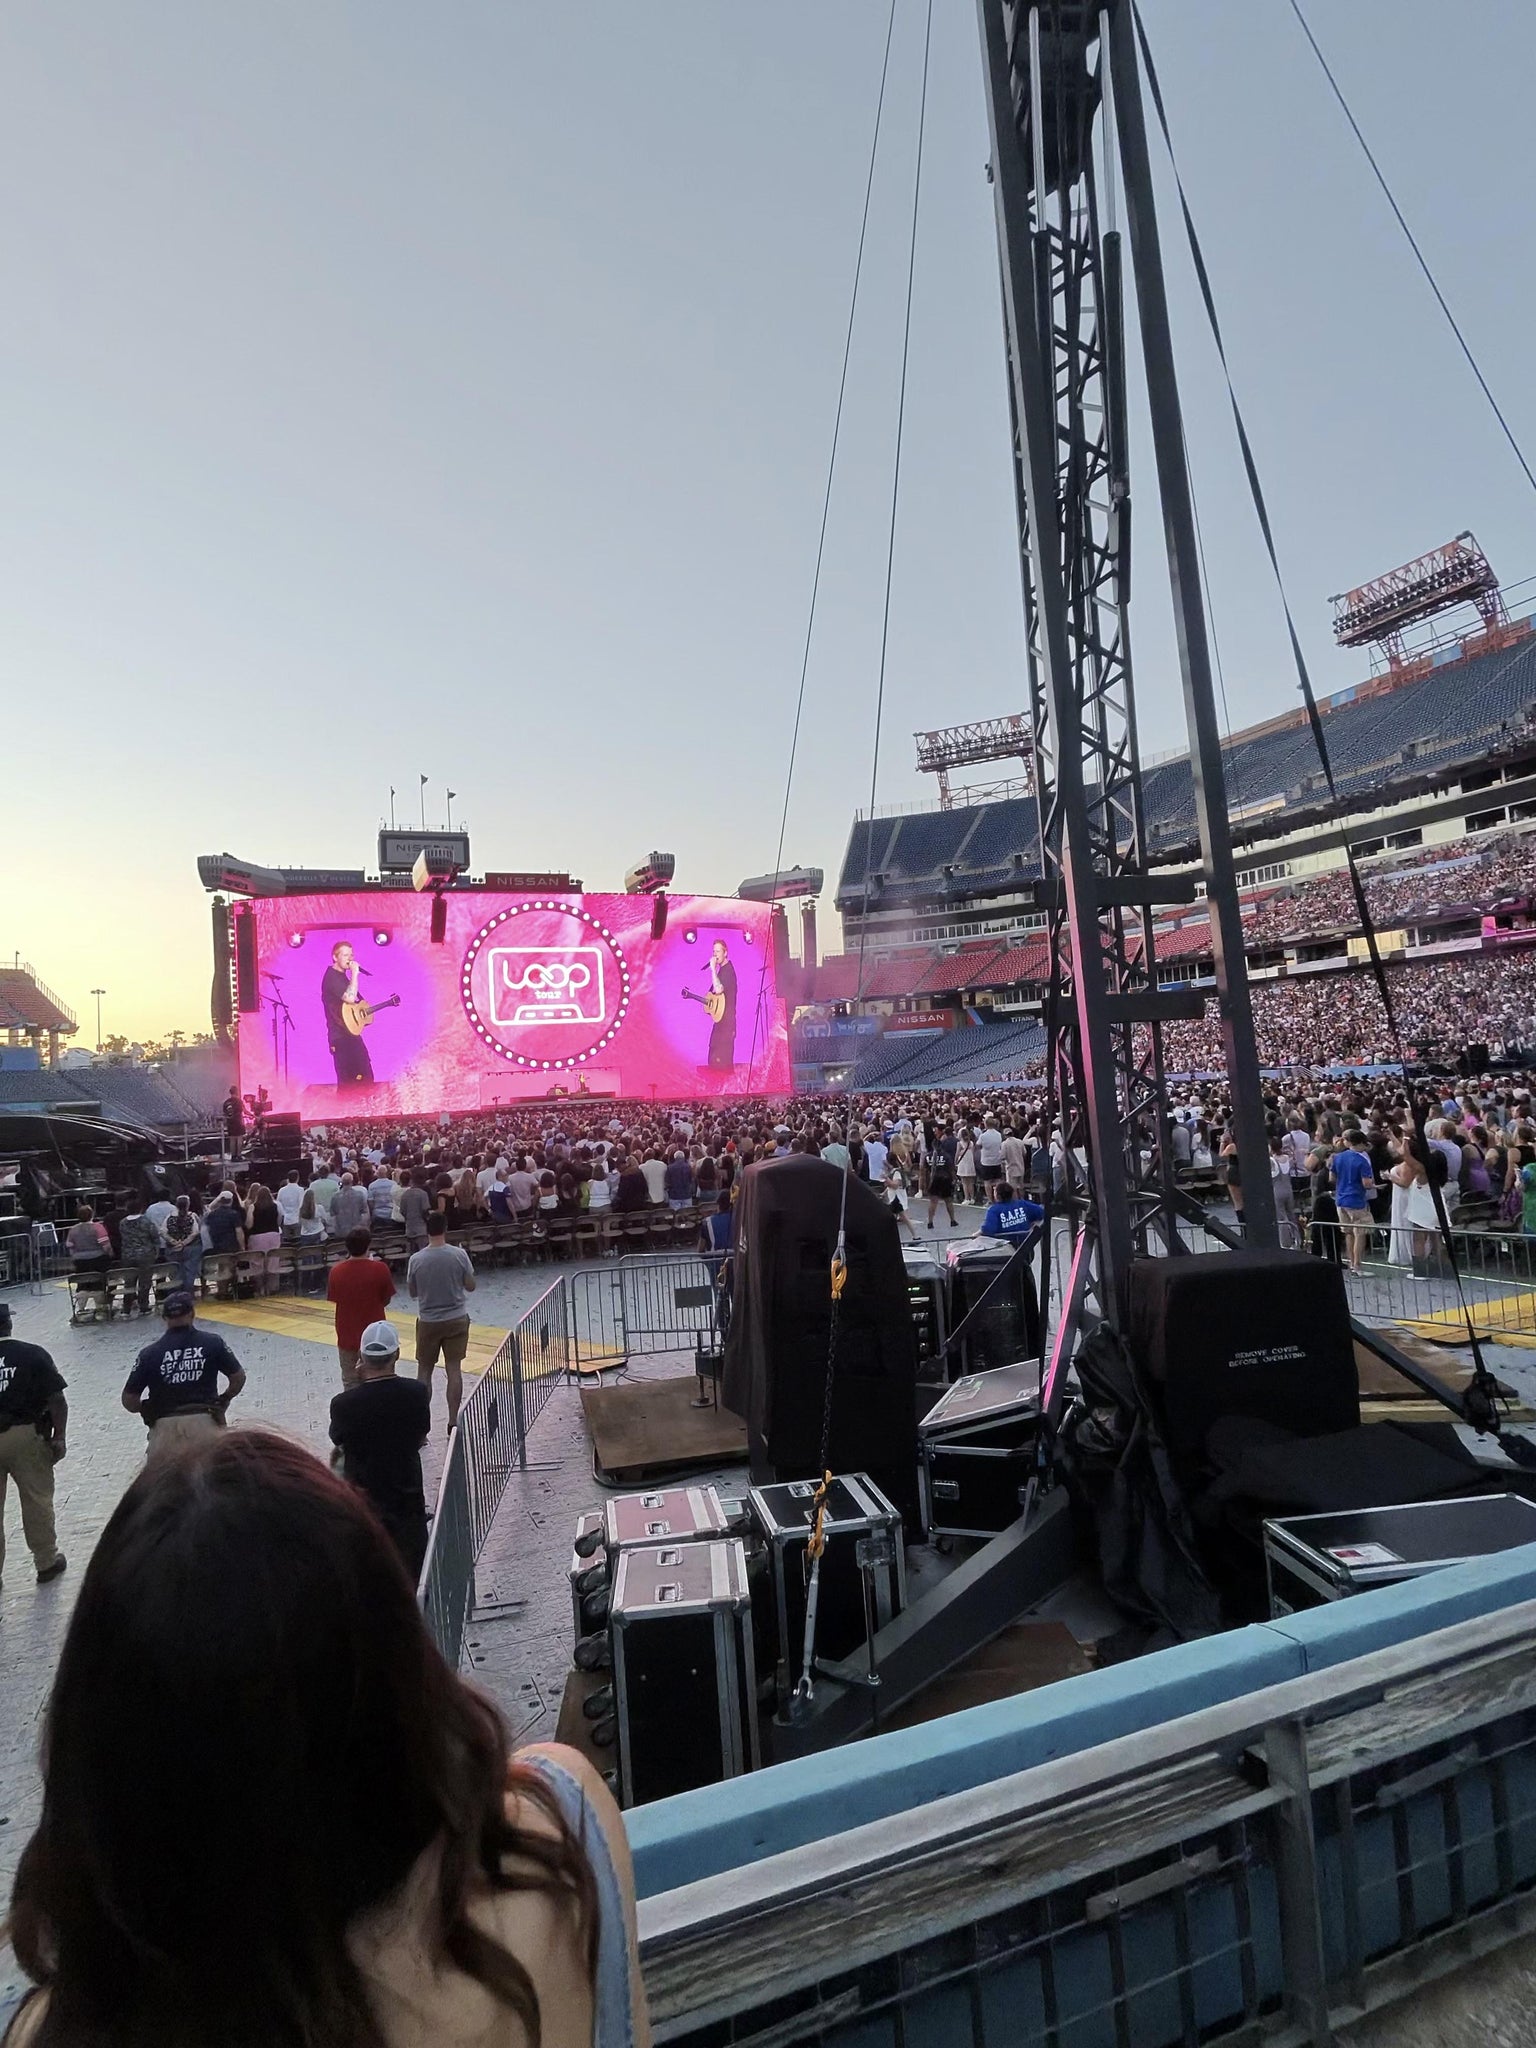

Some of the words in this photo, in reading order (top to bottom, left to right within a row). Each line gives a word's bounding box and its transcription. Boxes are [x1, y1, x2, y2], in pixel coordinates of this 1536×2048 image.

[497, 876, 559, 887] NISSAN
[897, 1013, 945, 1025] NISSAN
[162, 1346, 204, 1363] APEX
[1228, 1358, 1258, 1368] BEFORE
[1262, 1351, 1306, 1363] OPERATING
[1235, 1349, 1267, 1359] REMOVE
[1271, 1345, 1299, 1355] COVER
[160, 1358, 207, 1375] SECURITY
